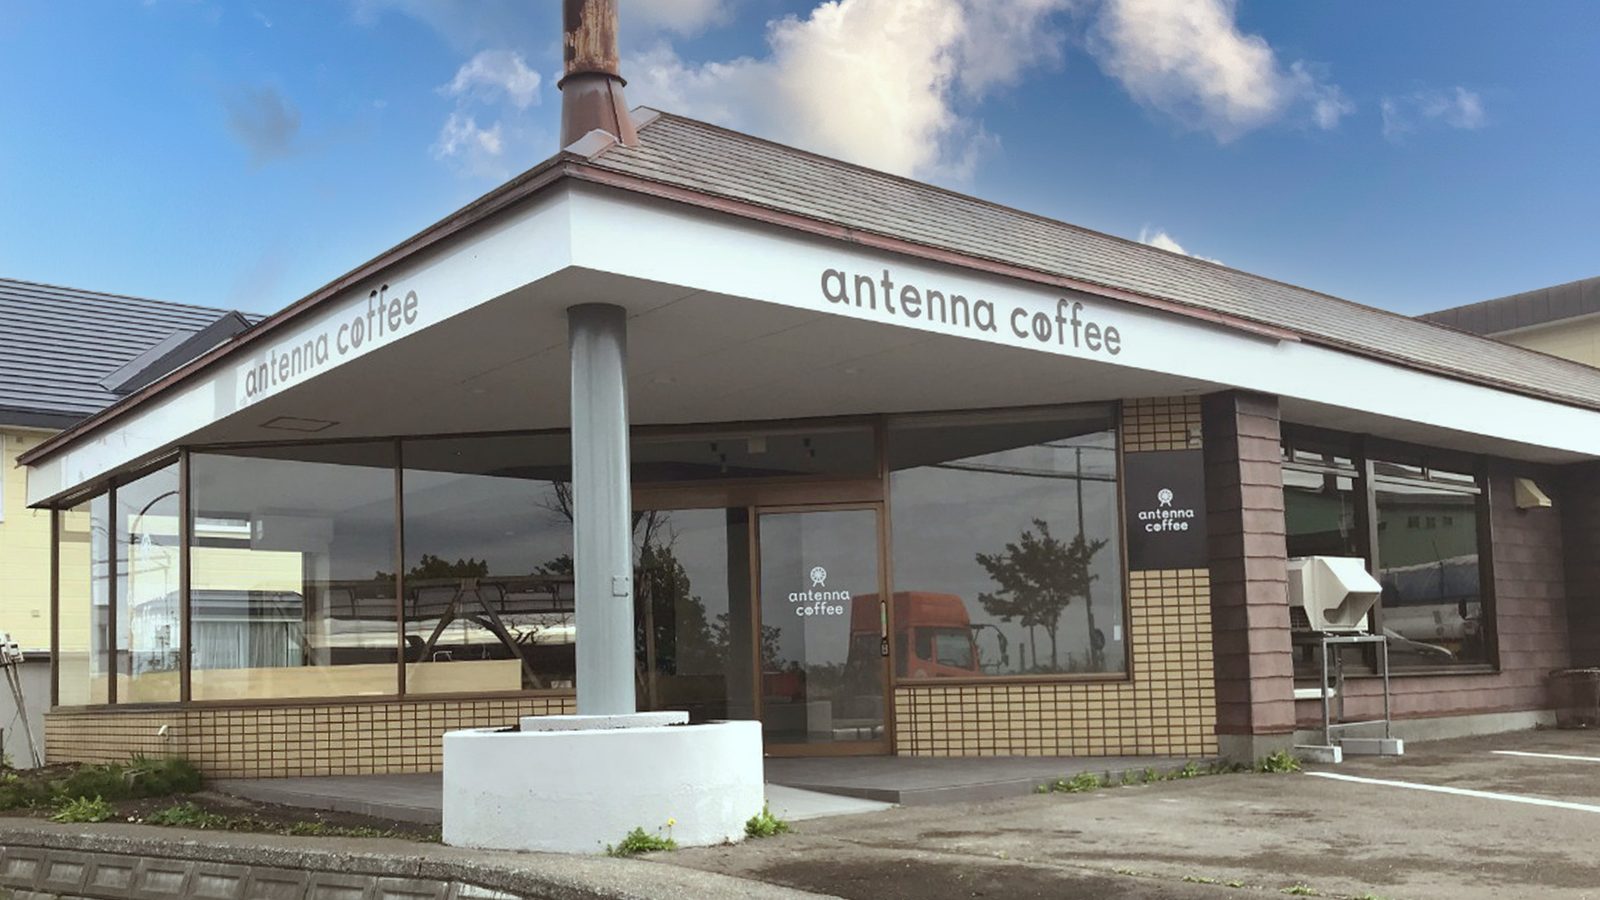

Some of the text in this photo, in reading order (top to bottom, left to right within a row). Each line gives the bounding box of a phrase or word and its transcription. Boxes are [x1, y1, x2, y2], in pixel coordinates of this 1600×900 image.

[821, 268, 1122, 355] antenna coffee
[245, 284, 418, 398] antenna coffee
[1138, 508, 1194, 520] antenna
[1145, 518, 1188, 532] coffee
[788, 589, 850, 602] antenna
[796, 601, 844, 616] coffee
